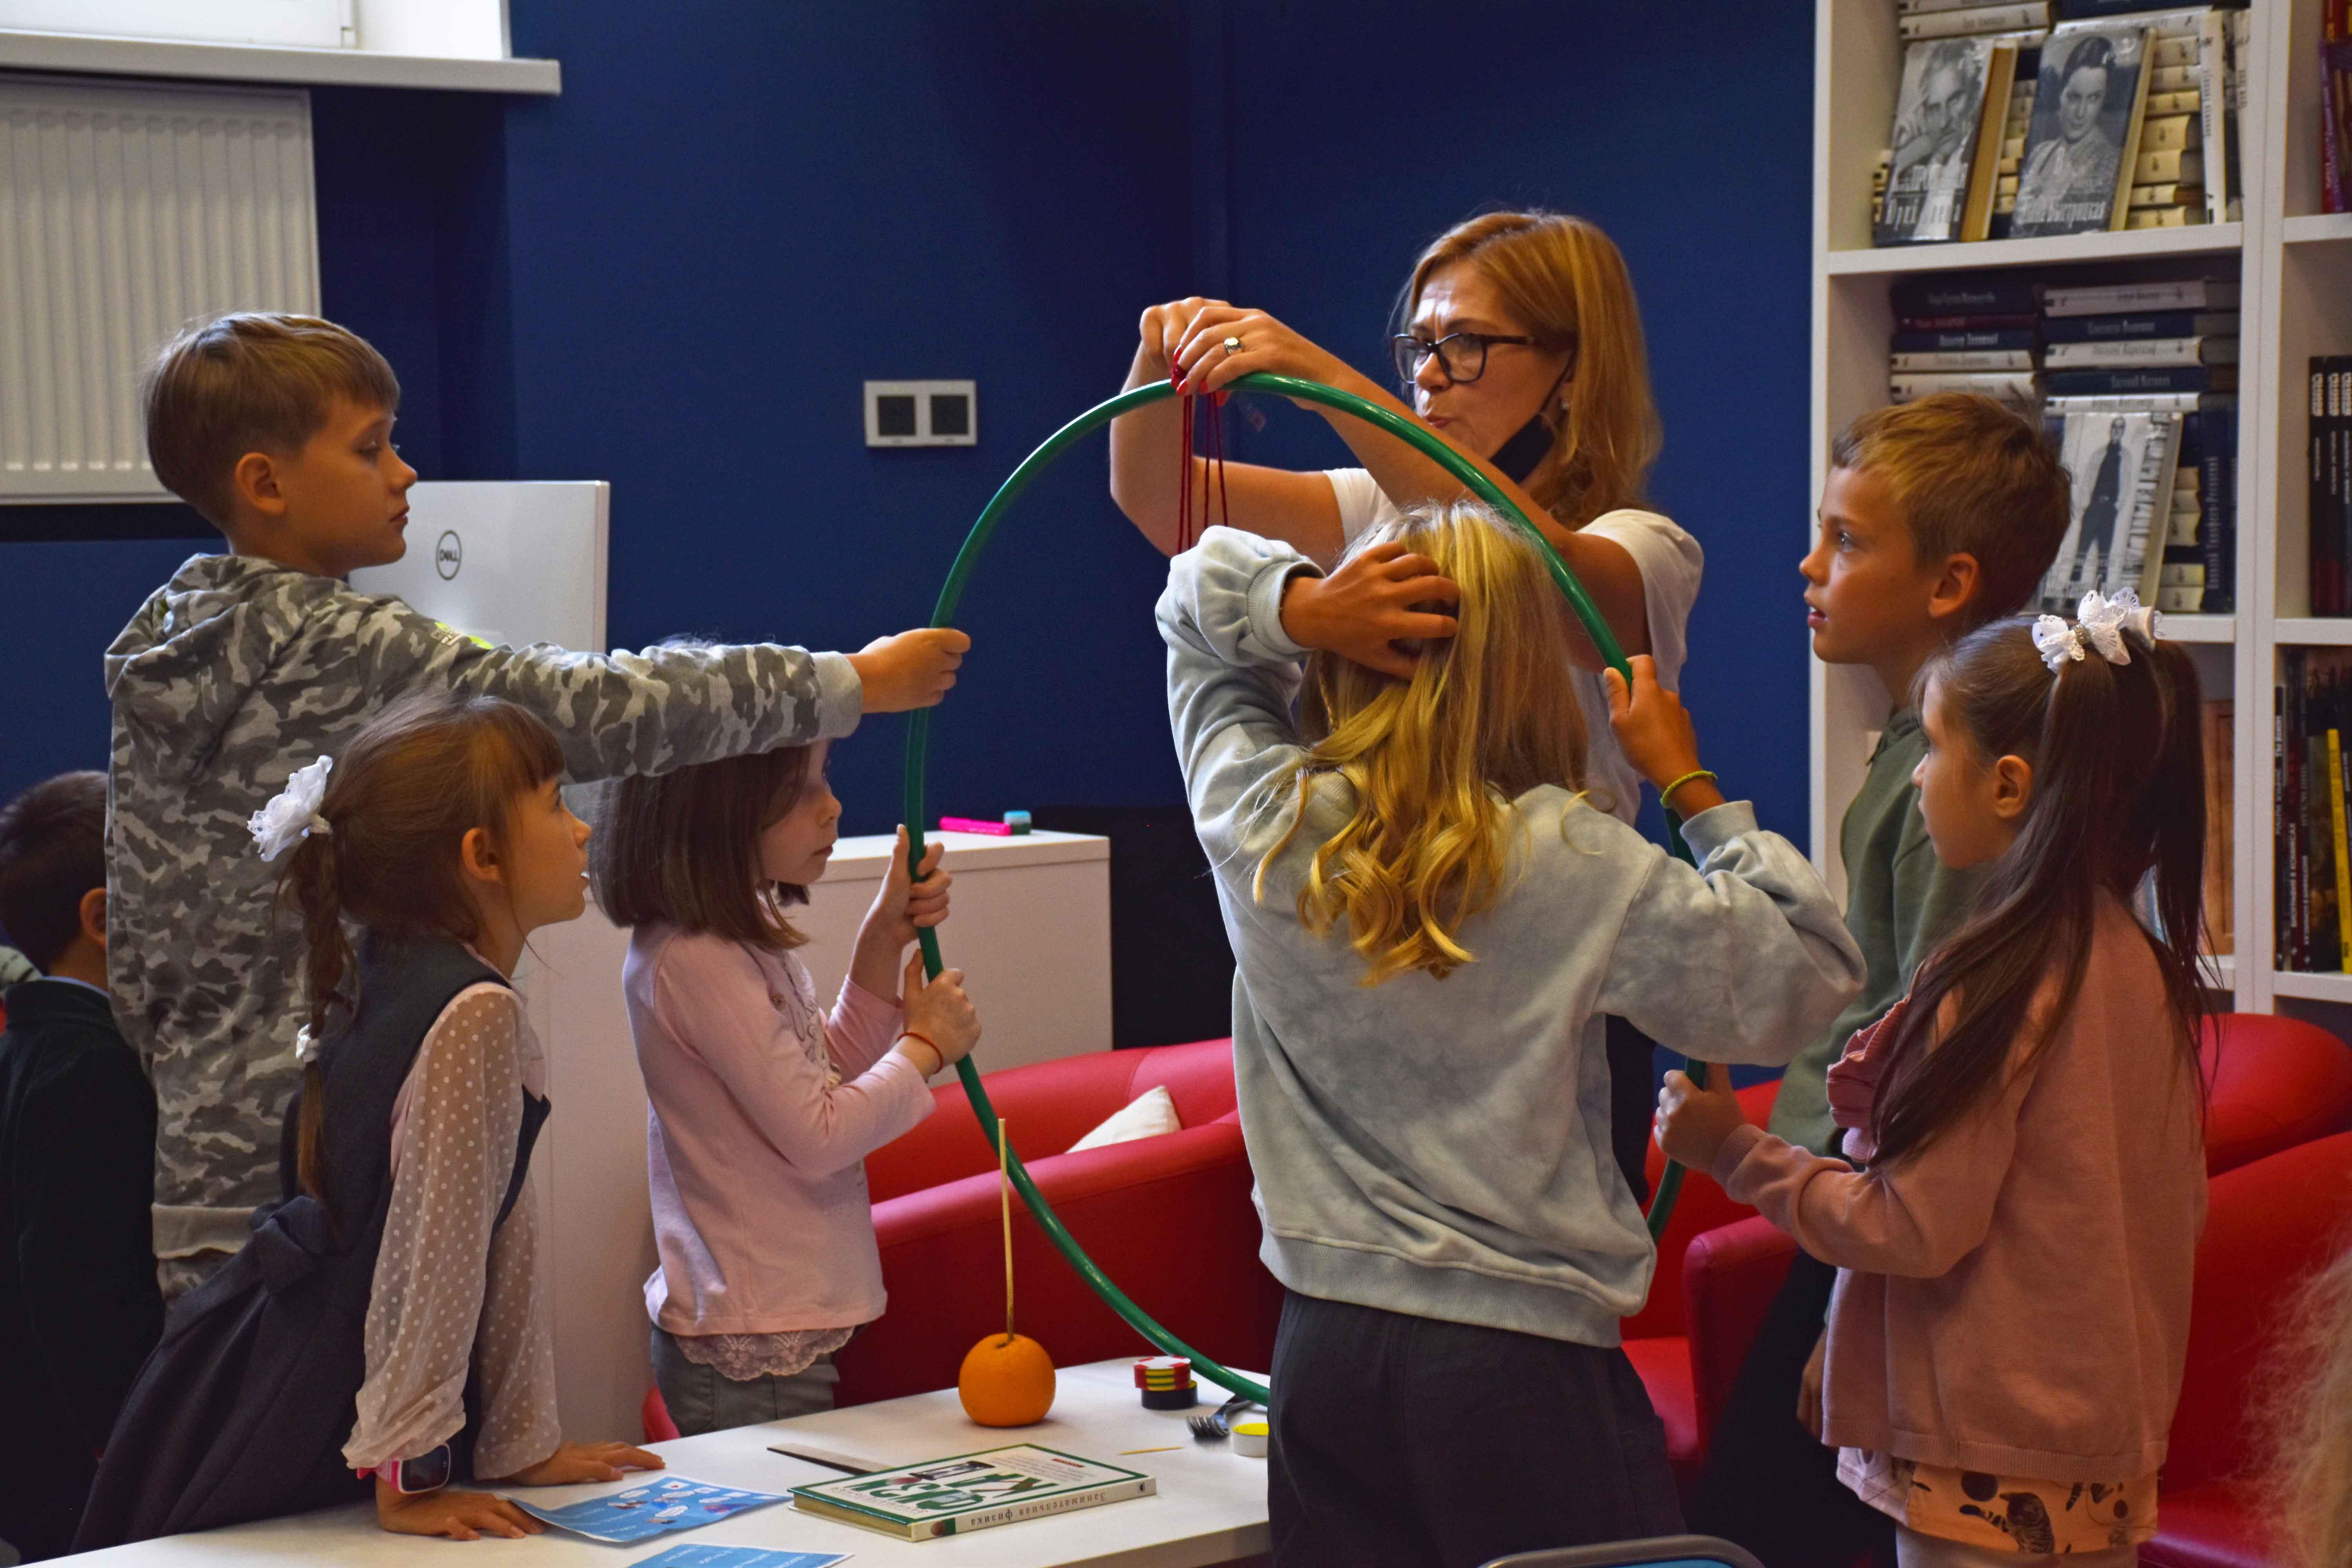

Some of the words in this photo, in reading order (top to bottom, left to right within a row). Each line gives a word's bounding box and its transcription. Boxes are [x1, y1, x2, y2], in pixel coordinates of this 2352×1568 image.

[439, 549, 459, 561] DELL
[1019, 1492, 1105, 1516] Занимательная
[971, 1509, 1013, 1526] физика
